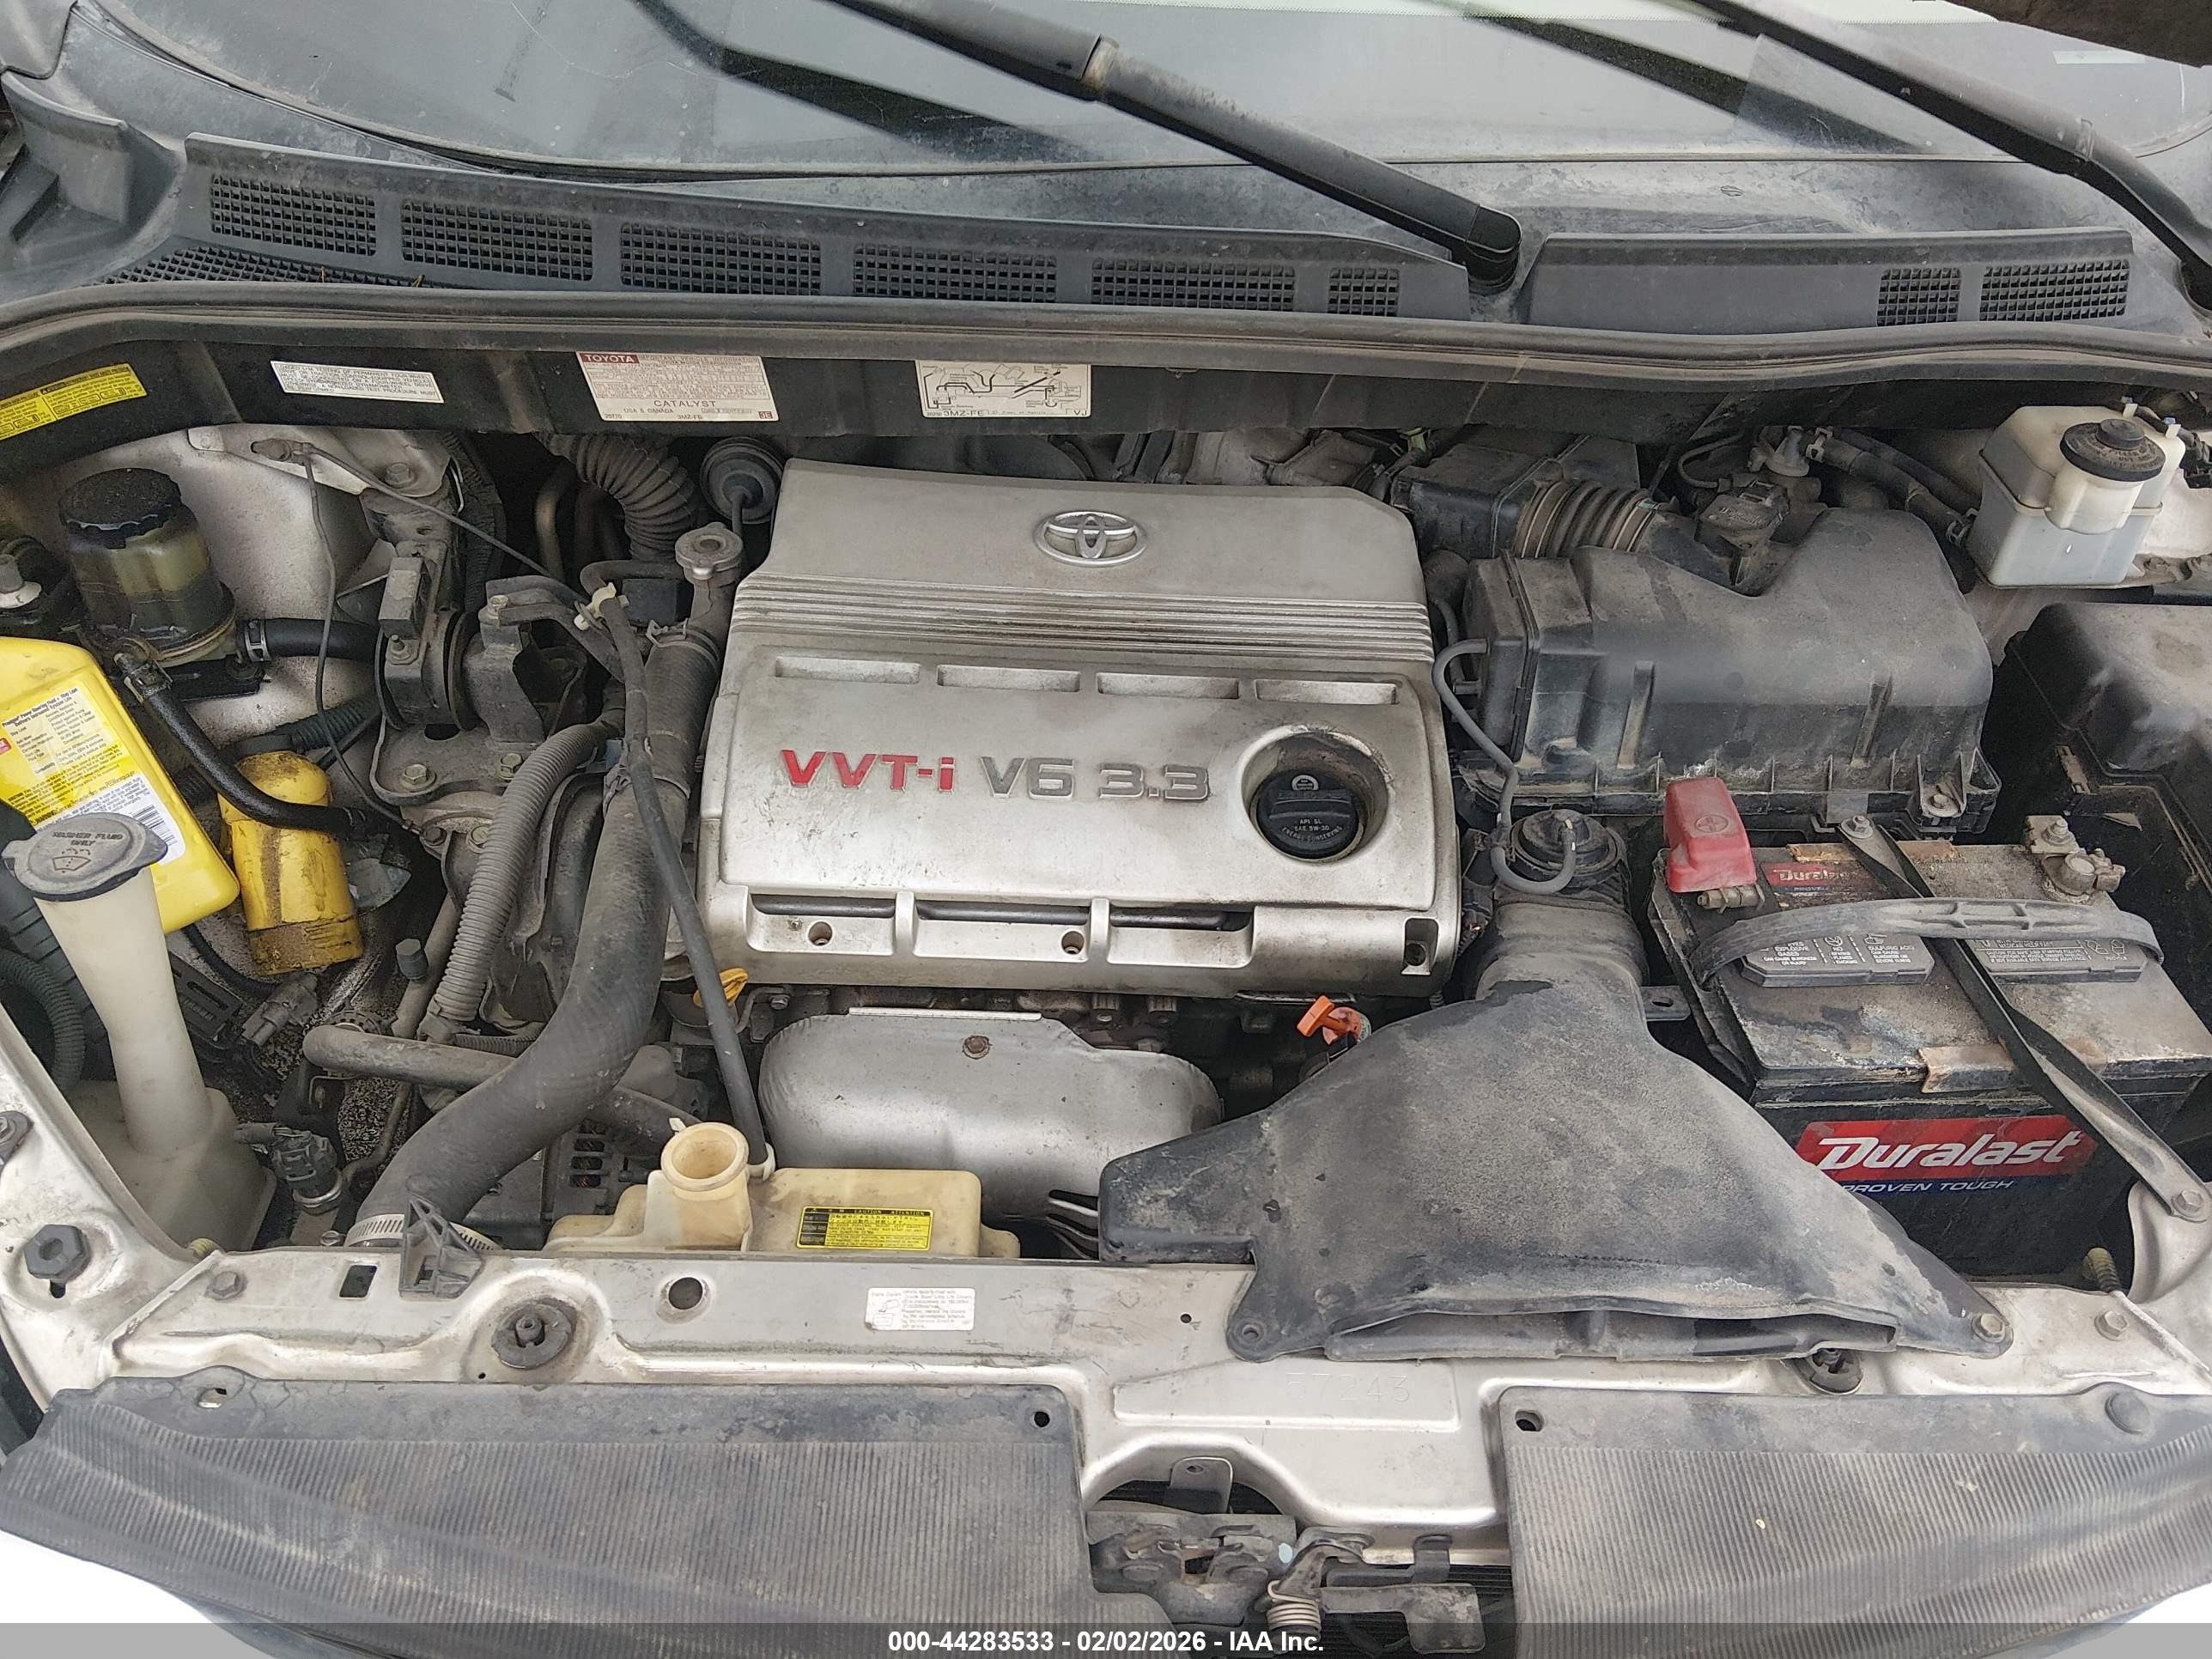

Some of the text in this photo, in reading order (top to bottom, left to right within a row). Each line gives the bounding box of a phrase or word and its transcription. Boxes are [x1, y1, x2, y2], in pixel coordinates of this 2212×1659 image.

[584, 354, 635, 363] TOYOTA
[653, 399, 716, 408] CATALYST
[781, 749, 1208, 803] VVT-i V6 3.3
[52, 831, 124, 841] WASHER FLUID
[1818, 1130, 2082, 1170] Duralast
[1842, 1180, 2014, 1194] PROVEN TOUGH
